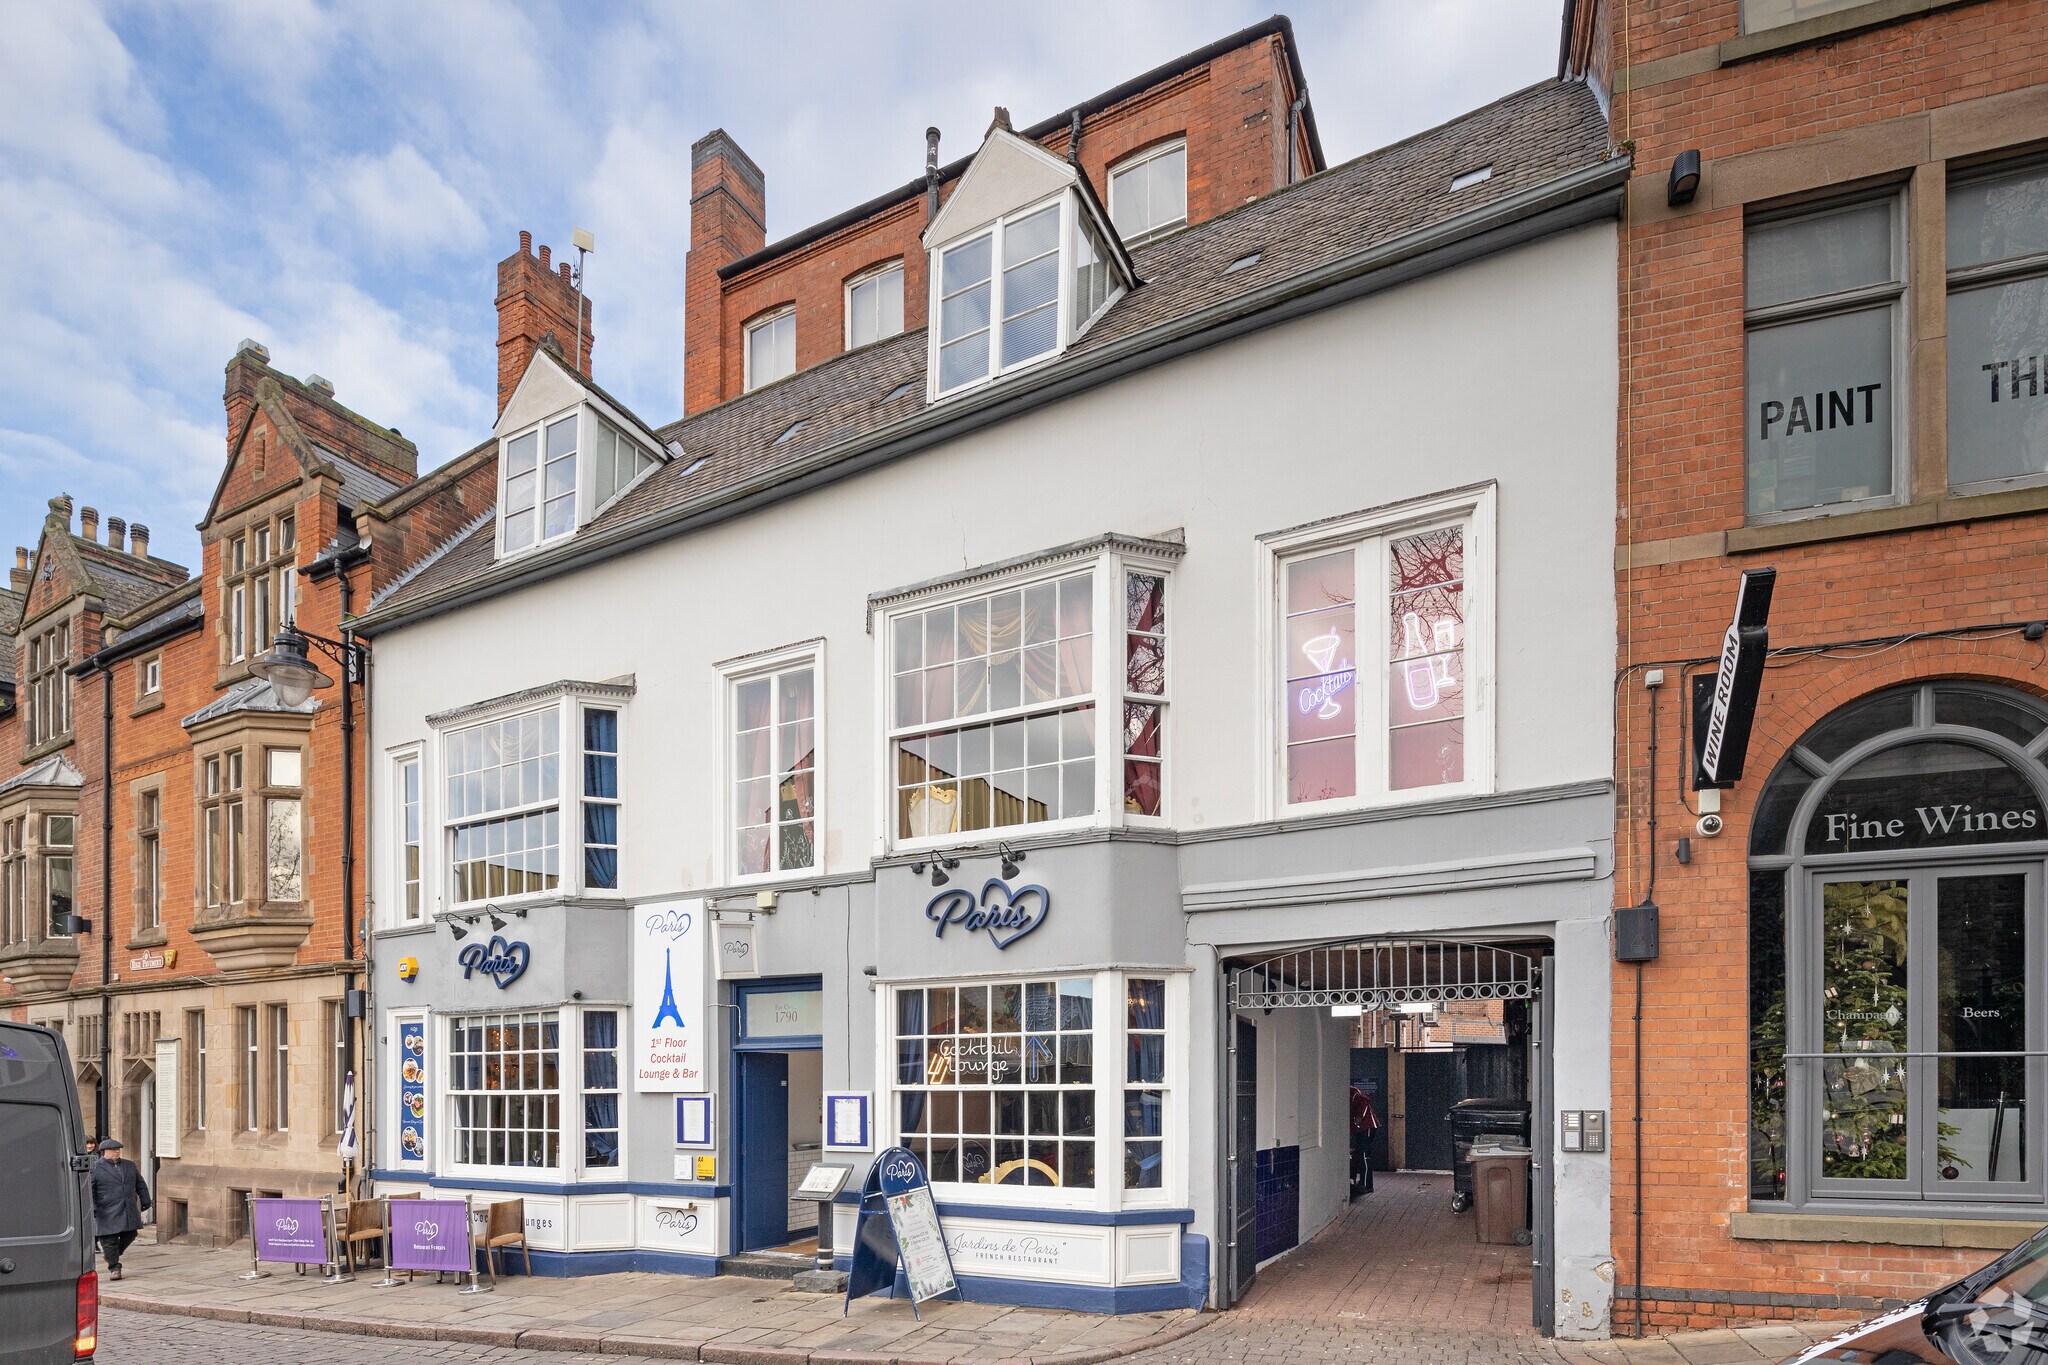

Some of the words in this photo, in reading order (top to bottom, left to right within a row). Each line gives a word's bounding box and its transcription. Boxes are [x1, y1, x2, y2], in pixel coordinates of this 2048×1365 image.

[1981, 355, 2048, 403] TH
[1760, 383, 1882, 440] PAINT
[1299, 658, 1353, 712] Cocktails
[1705, 705, 1725, 769] WINE
[1717, 633, 1738, 706] ROOM
[1824, 813, 1905, 842] Fine
[1914, 804, 2037, 835] Wines
[926, 888, 1033, 938] Paris
[645, 912, 685, 936] Paris
[723, 941, 747, 955] Paris
[458, 942, 521, 981] Paris
[775, 1010, 798, 1023] 1790
[1826, 1009, 1903, 1021] Champagne
[1962, 1006, 2000, 1018] Beers
[650, 1038, 662, 1049] 1st
[664, 1037, 688, 1048] Floor
[940, 1036, 1014, 1057] Cocktail
[650, 1053, 687, 1063] Cocktail
[639, 1069, 671, 1081] Lounge
[672, 1068, 681, 1079] &
[682, 1068, 699, 1079] Bar
[886, 1163, 912, 1182] Paris
[275, 1218, 297, 1232] Paris
[414, 1221, 436, 1237] Paris
[525, 1217, 553, 1230] unges
[655, 1211, 692, 1230] Paris
[948, 1232, 999, 1257] Jardins
[1001, 1238, 1018, 1253] de
[975, 1252, 1004, 1260] FRENCH
[1008, 1254, 1058, 1265] RESTAURANT
